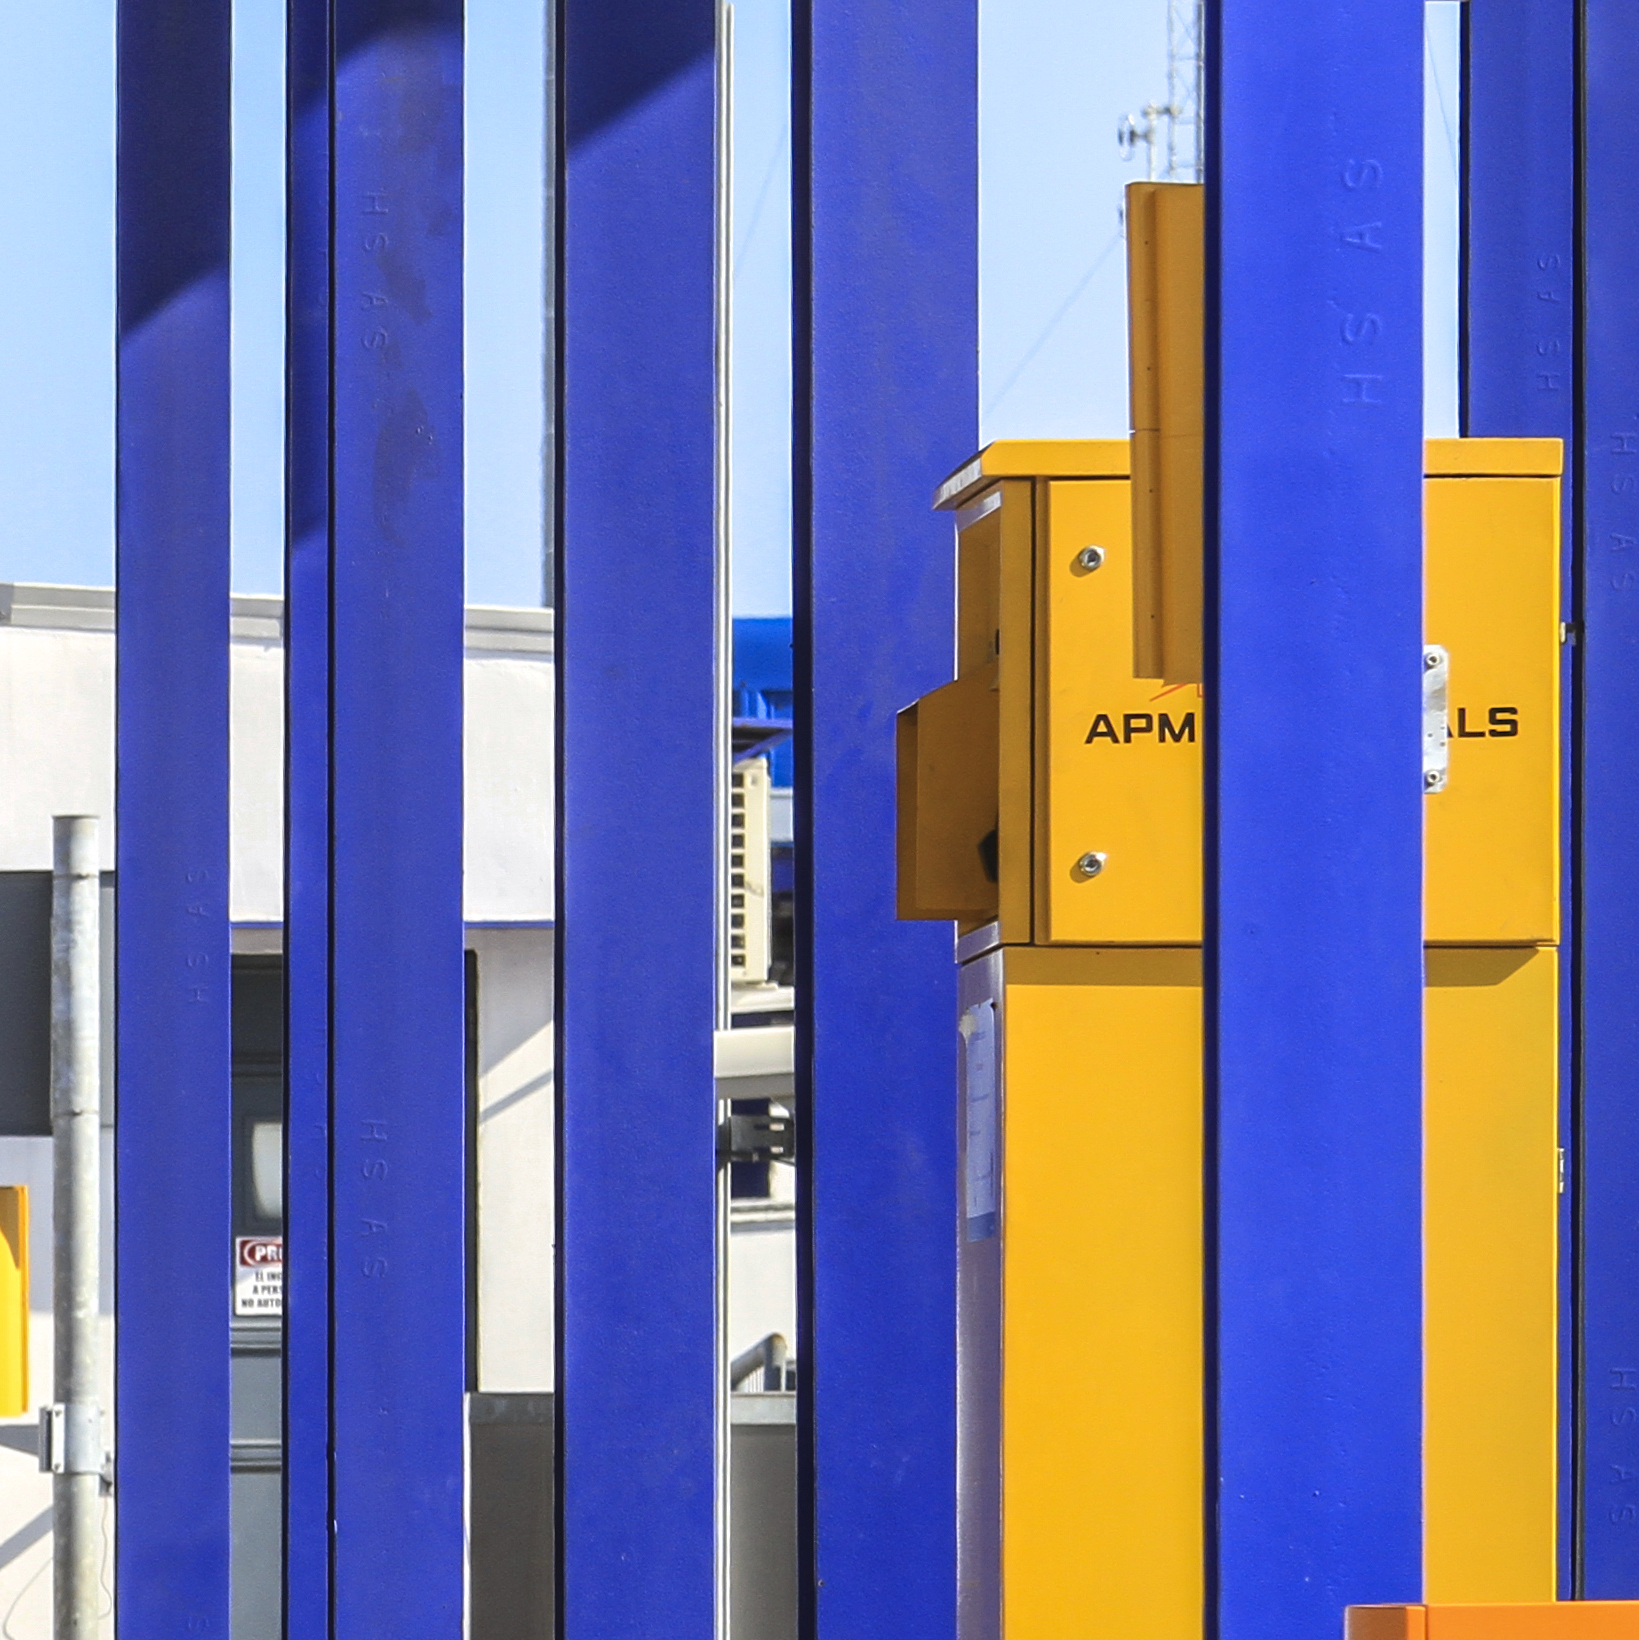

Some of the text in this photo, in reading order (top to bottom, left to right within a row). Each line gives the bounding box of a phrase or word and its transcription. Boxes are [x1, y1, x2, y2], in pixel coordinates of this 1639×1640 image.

[1084, 707, 1519, 744] APM LS
[241, 1299, 254, 1308] NO
